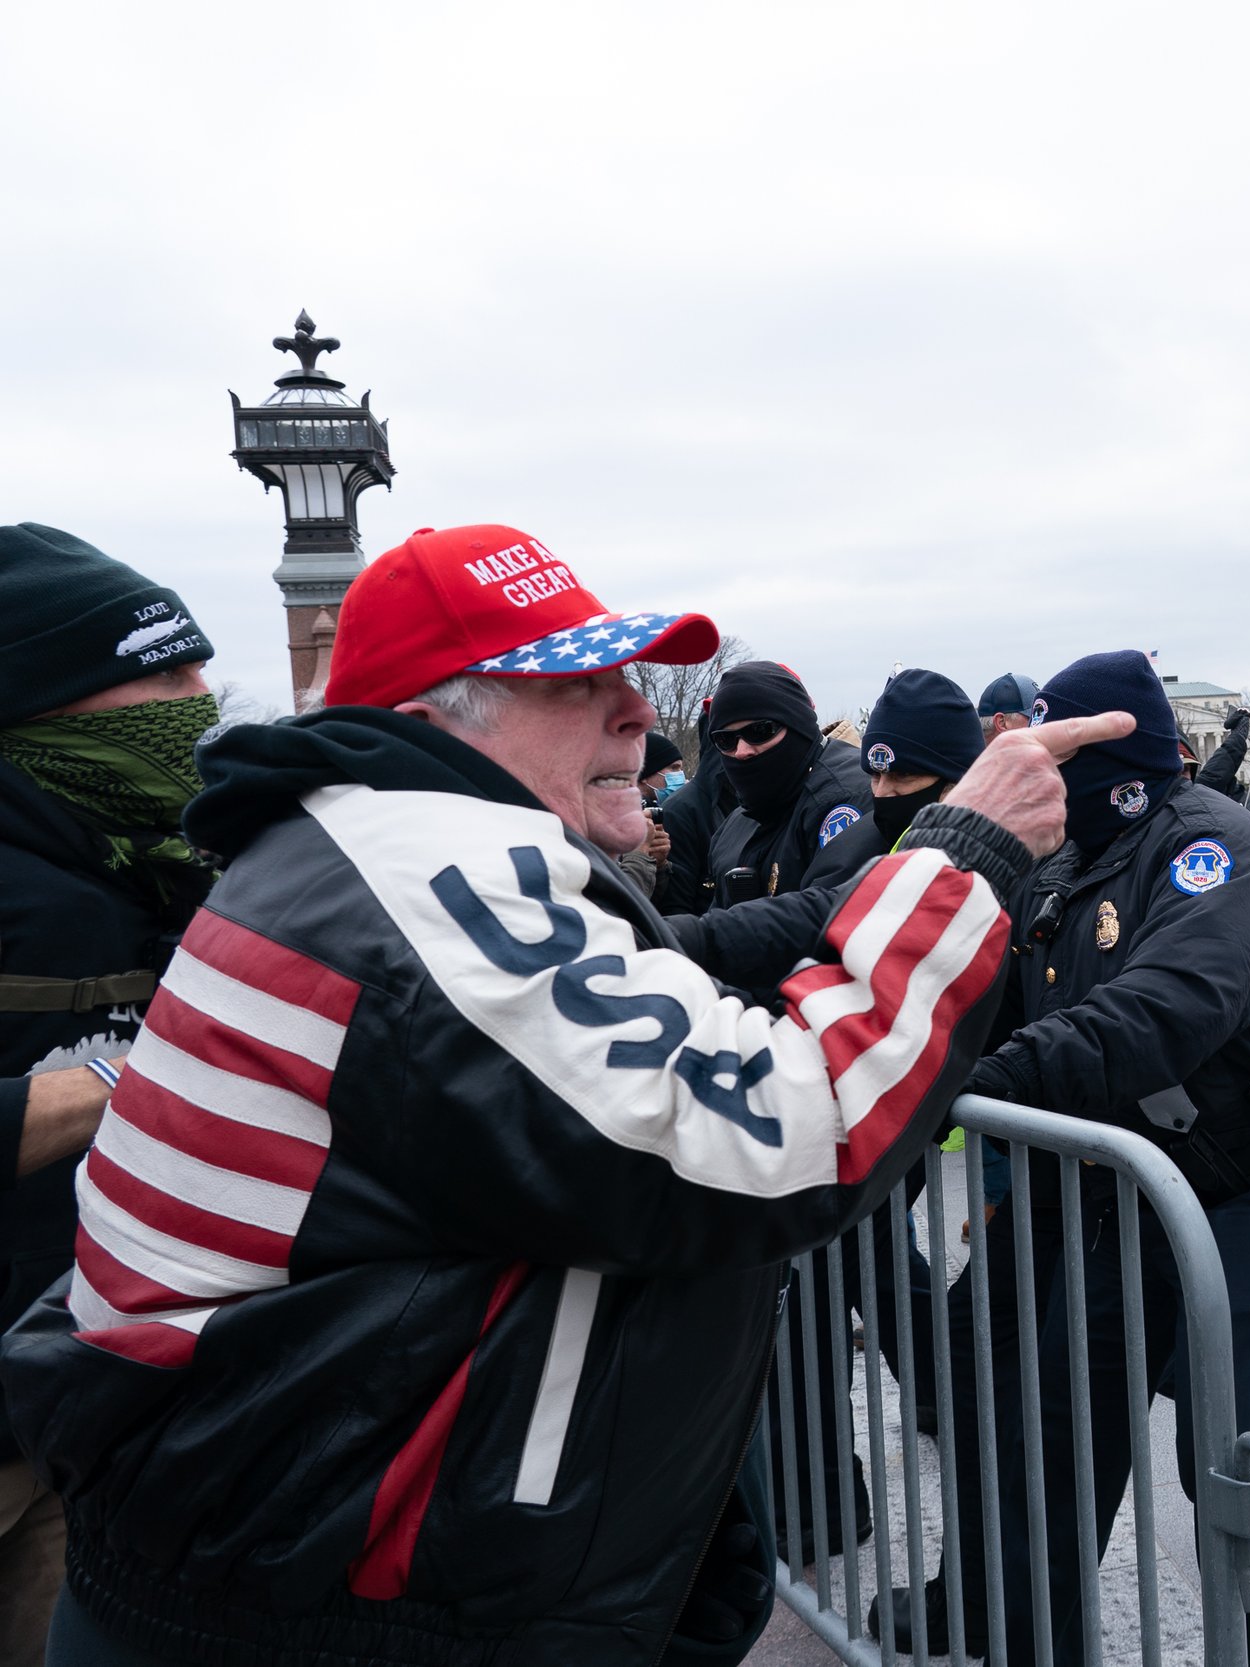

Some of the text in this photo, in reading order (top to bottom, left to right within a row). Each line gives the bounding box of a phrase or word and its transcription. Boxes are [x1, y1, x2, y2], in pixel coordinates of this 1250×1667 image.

[463, 543, 539, 586] MAKE
[502, 565, 576, 608] GREAT
[134, 601, 170, 622] LOUD
[138, 634, 201, 665] MAJORIT
[429, 845, 784, 1148] USA
